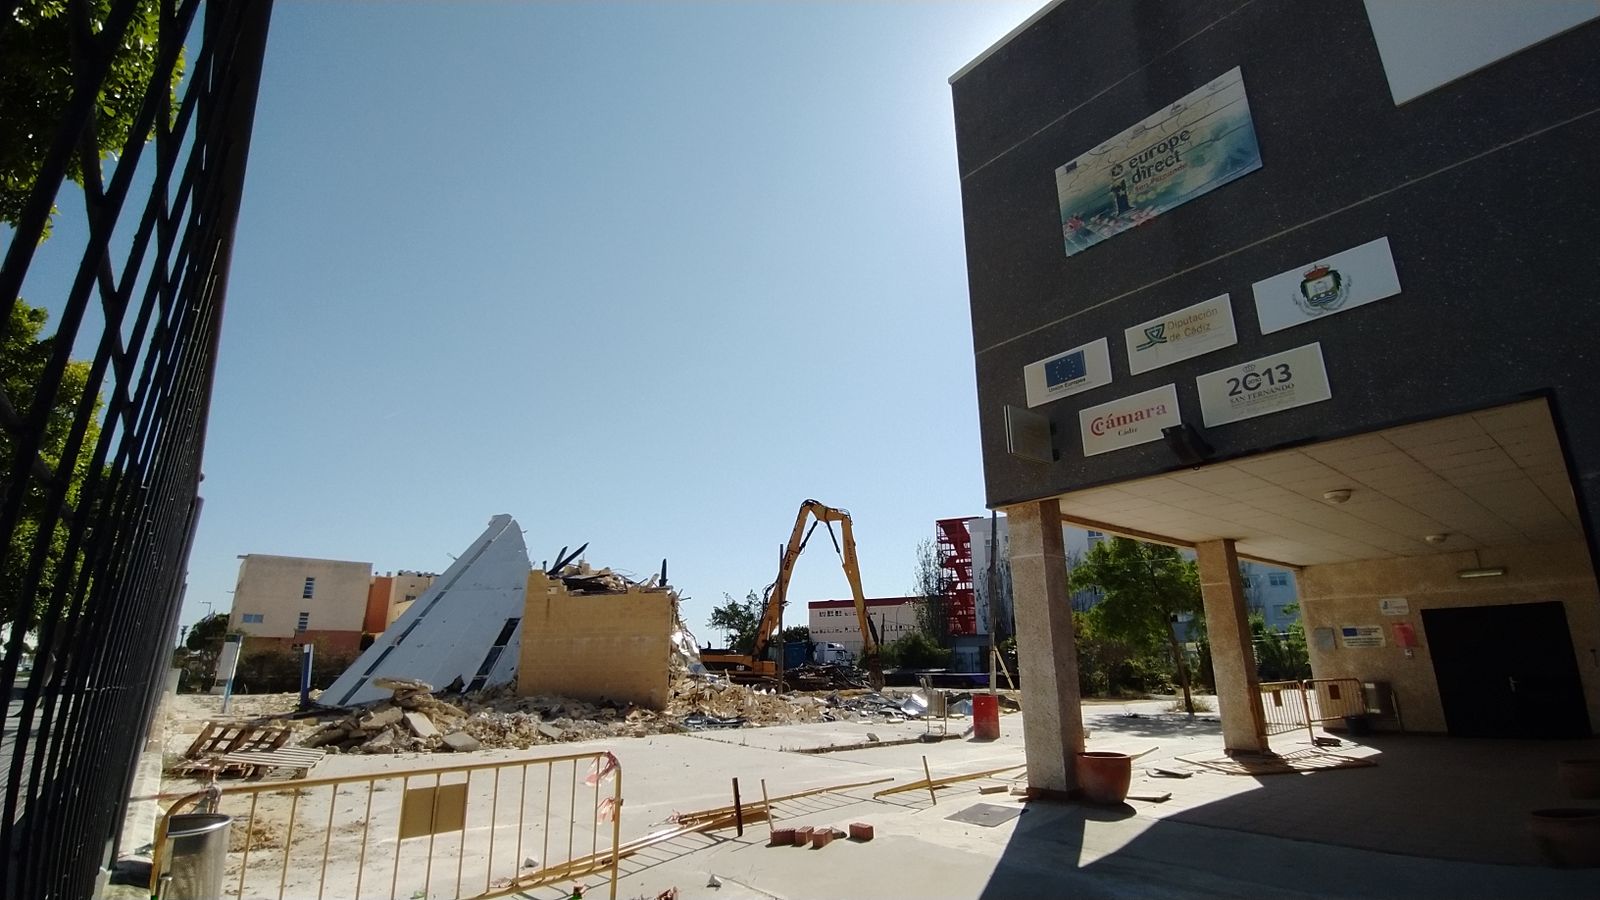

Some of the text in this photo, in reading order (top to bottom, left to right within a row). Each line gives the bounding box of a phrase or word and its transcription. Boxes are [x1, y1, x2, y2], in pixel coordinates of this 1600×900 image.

[1129, 130, 1191, 168] europe
[1132, 150, 1181, 183] direct
[1167, 307, 1218, 330] Diputación
[1169, 332, 1180, 342] de
[1248, 382, 1295, 401] FERNANDO
[1090, 403, 1167, 436] Cámara
